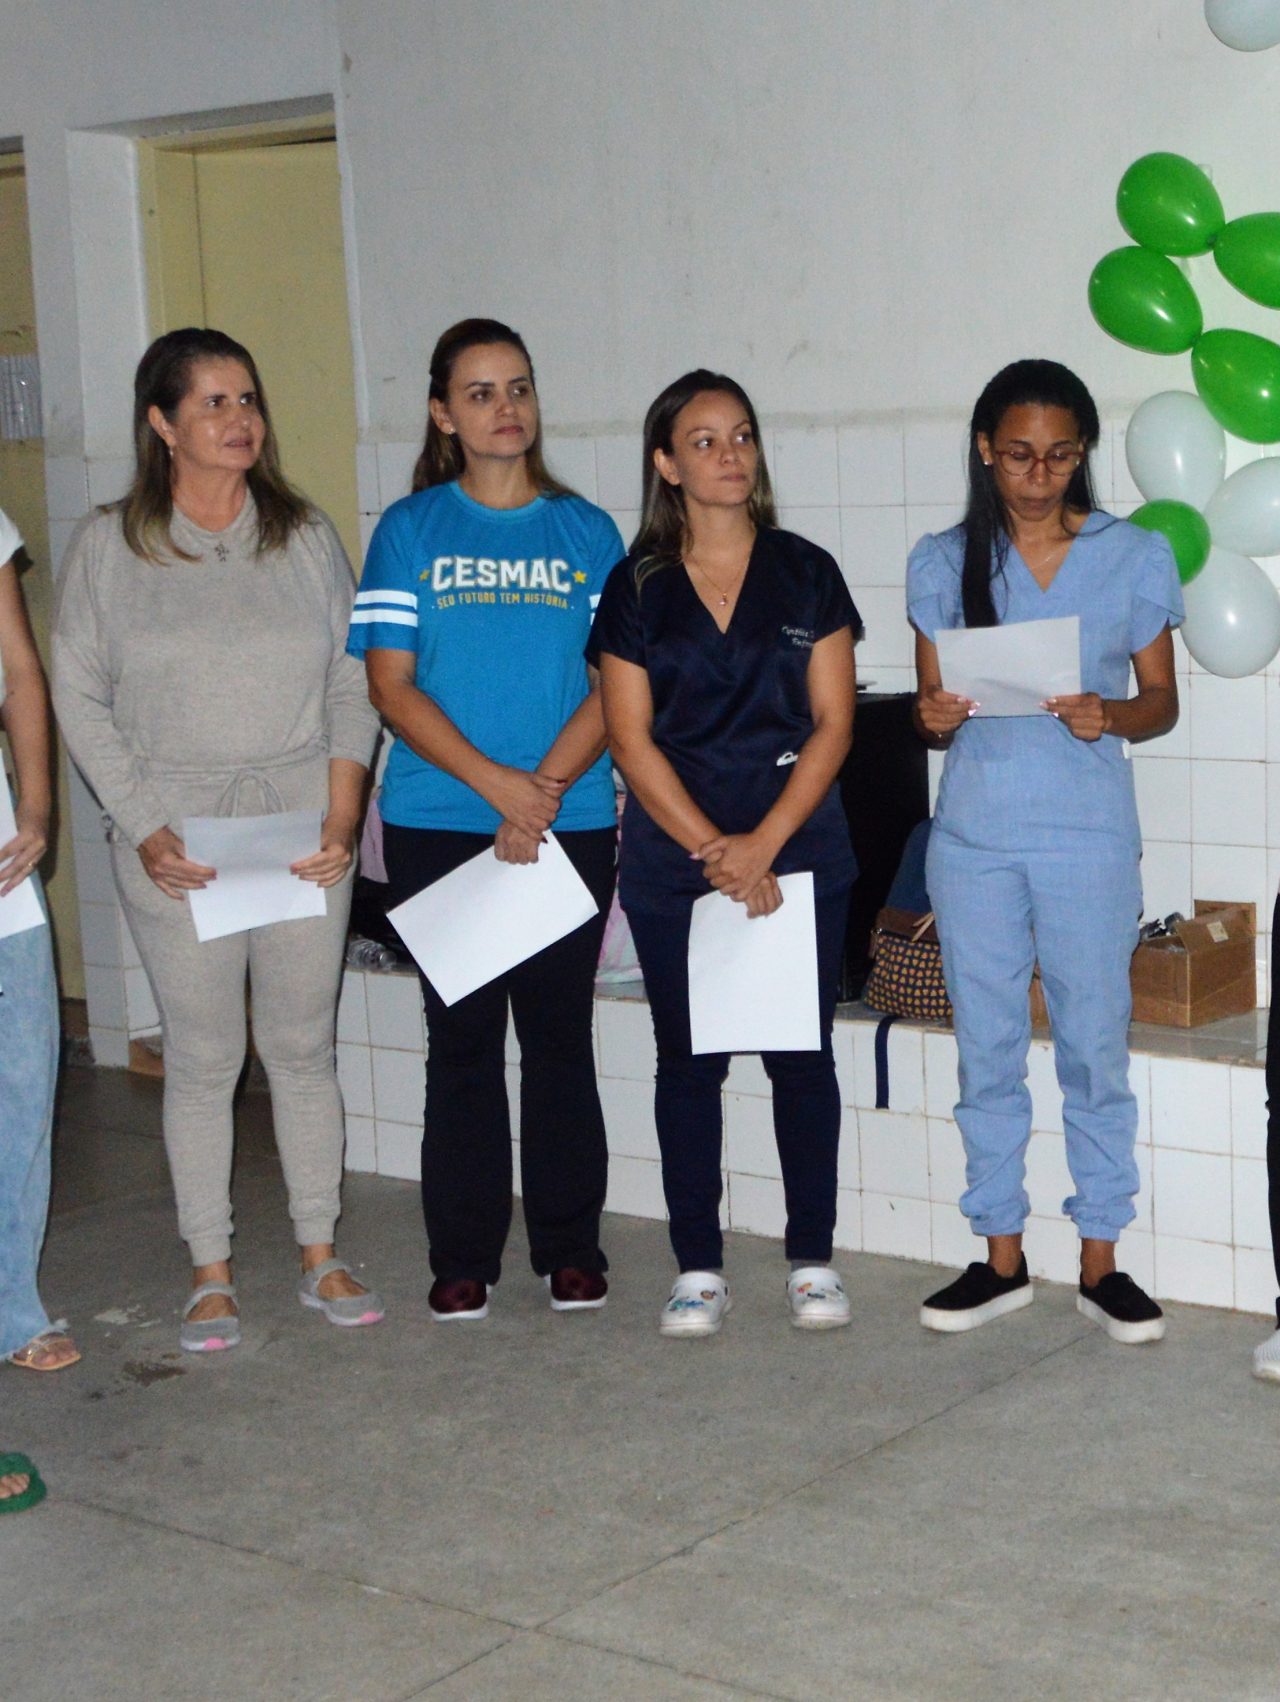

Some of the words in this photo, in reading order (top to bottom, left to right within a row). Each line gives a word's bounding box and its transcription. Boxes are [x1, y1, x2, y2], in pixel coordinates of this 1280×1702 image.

[432, 555, 572, 593] CESMAC
[437, 593, 456, 610] SEU
[459, 592, 496, 604] FUTURO
[501, 592, 521, 604] TEM
